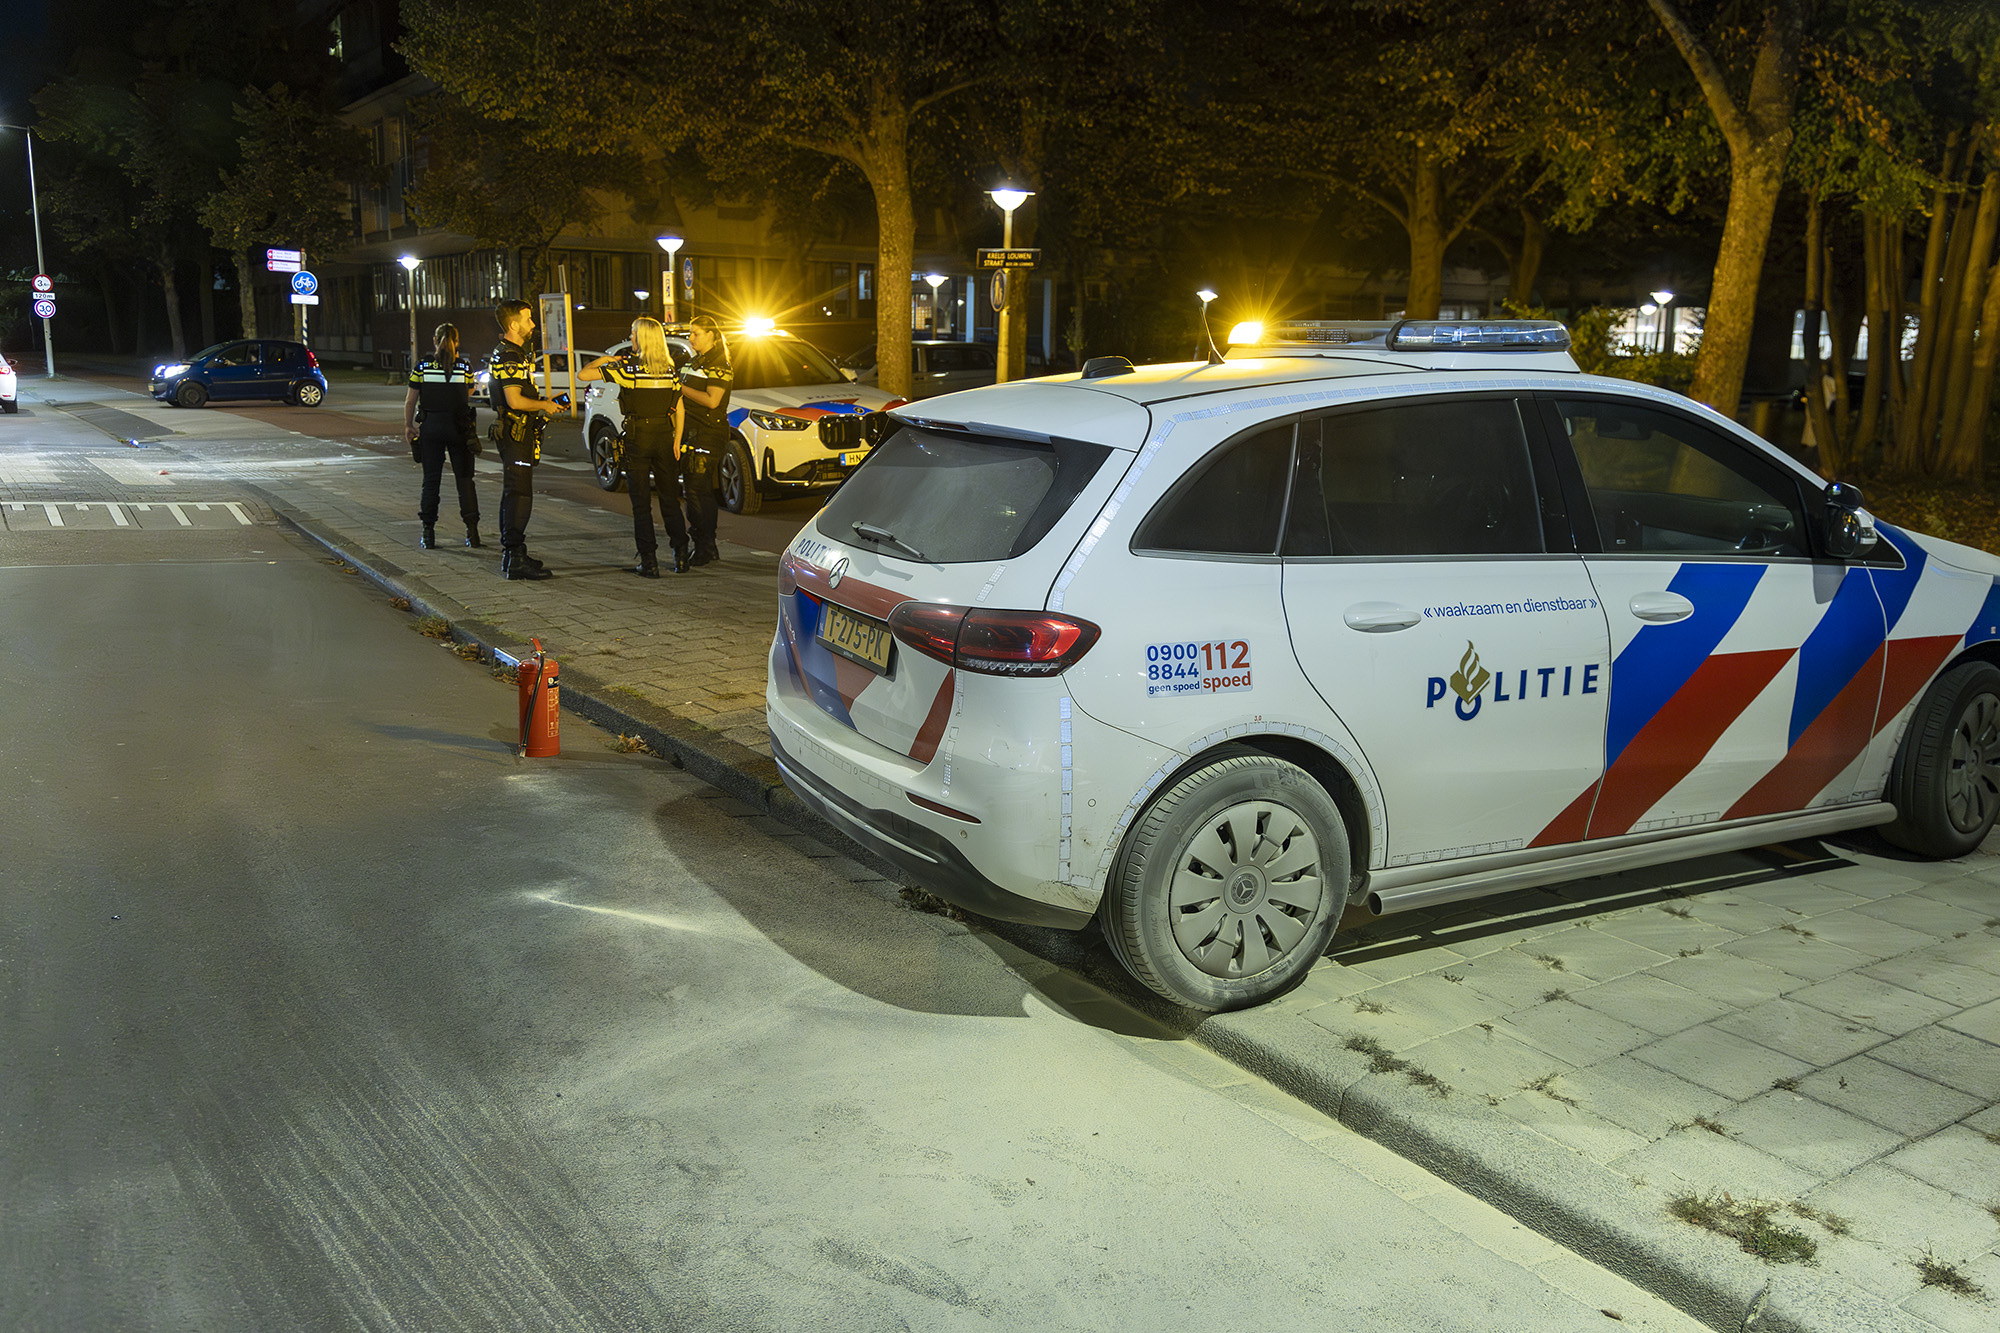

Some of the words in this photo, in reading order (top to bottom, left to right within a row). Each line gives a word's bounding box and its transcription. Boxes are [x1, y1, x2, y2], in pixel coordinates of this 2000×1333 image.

[39, 304, 52, 313] 30
[1505, 603, 1522, 613] en
[829, 609, 885, 661] T-275-PK
[1147, 643, 1198, 661] 0900
[1201, 640, 1250, 670] 112
[1148, 662, 1199, 680] 8844
[1148, 684, 1171, 694] geen
[1173, 681, 1200, 693] spoed
[1203, 671, 1252, 692] spoed
[1426, 663, 1599, 721] POLITIE
